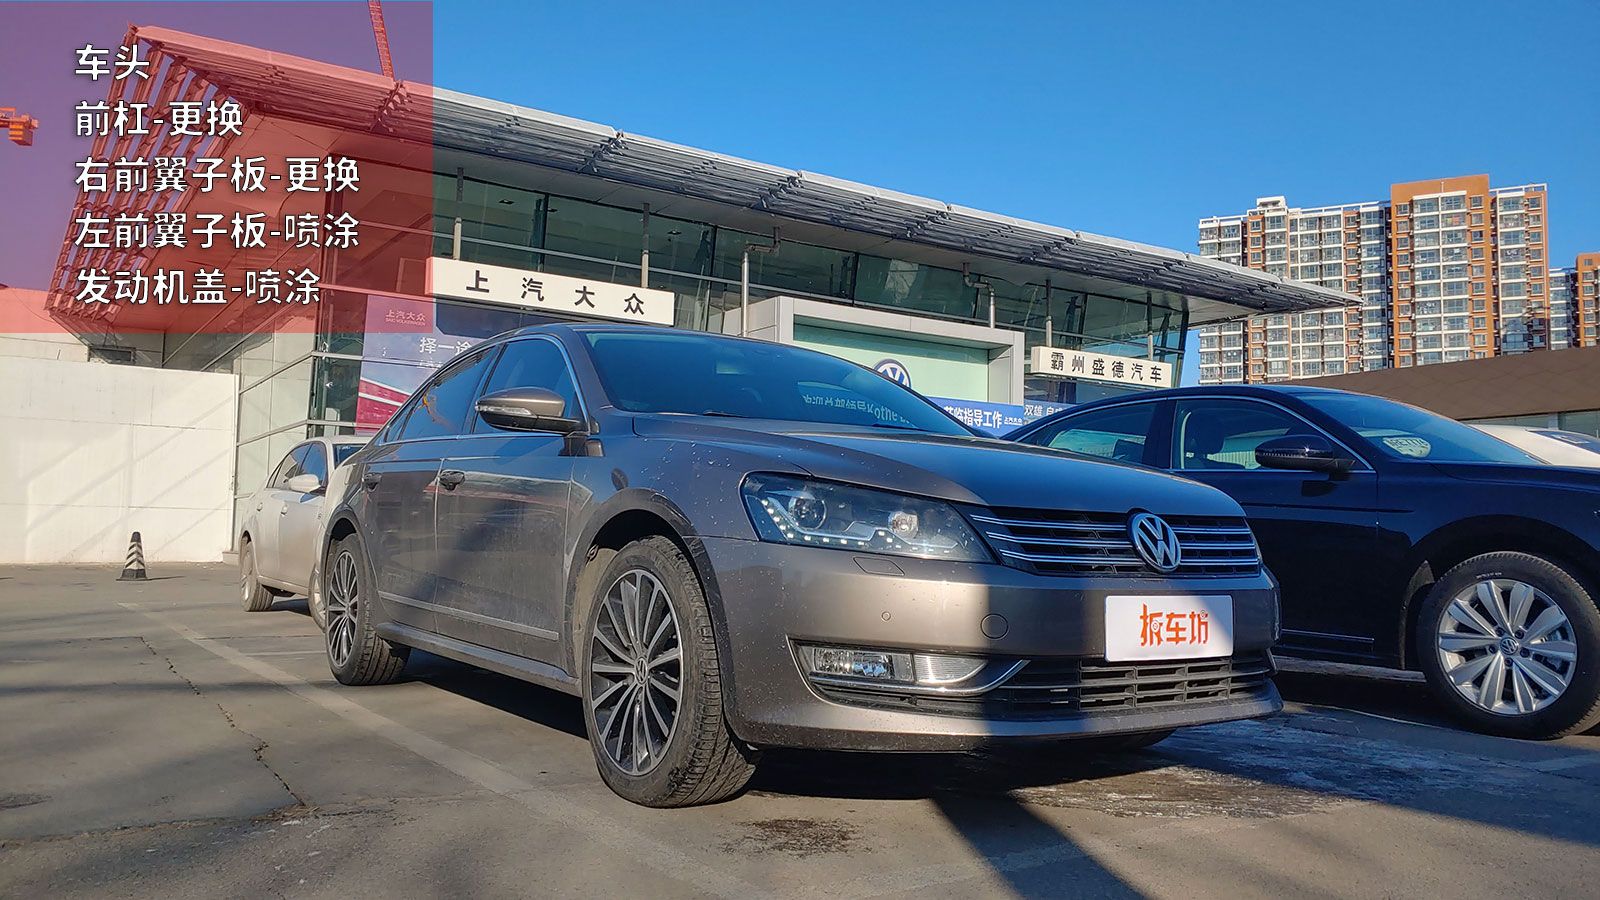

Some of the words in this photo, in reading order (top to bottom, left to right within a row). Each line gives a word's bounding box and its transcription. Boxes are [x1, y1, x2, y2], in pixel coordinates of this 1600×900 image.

[466, 269, 645, 315] 上汽大众
[385, 309, 426, 322] 上汽大众
[1050, 351, 1162, 383] 霸州盛德汽车
